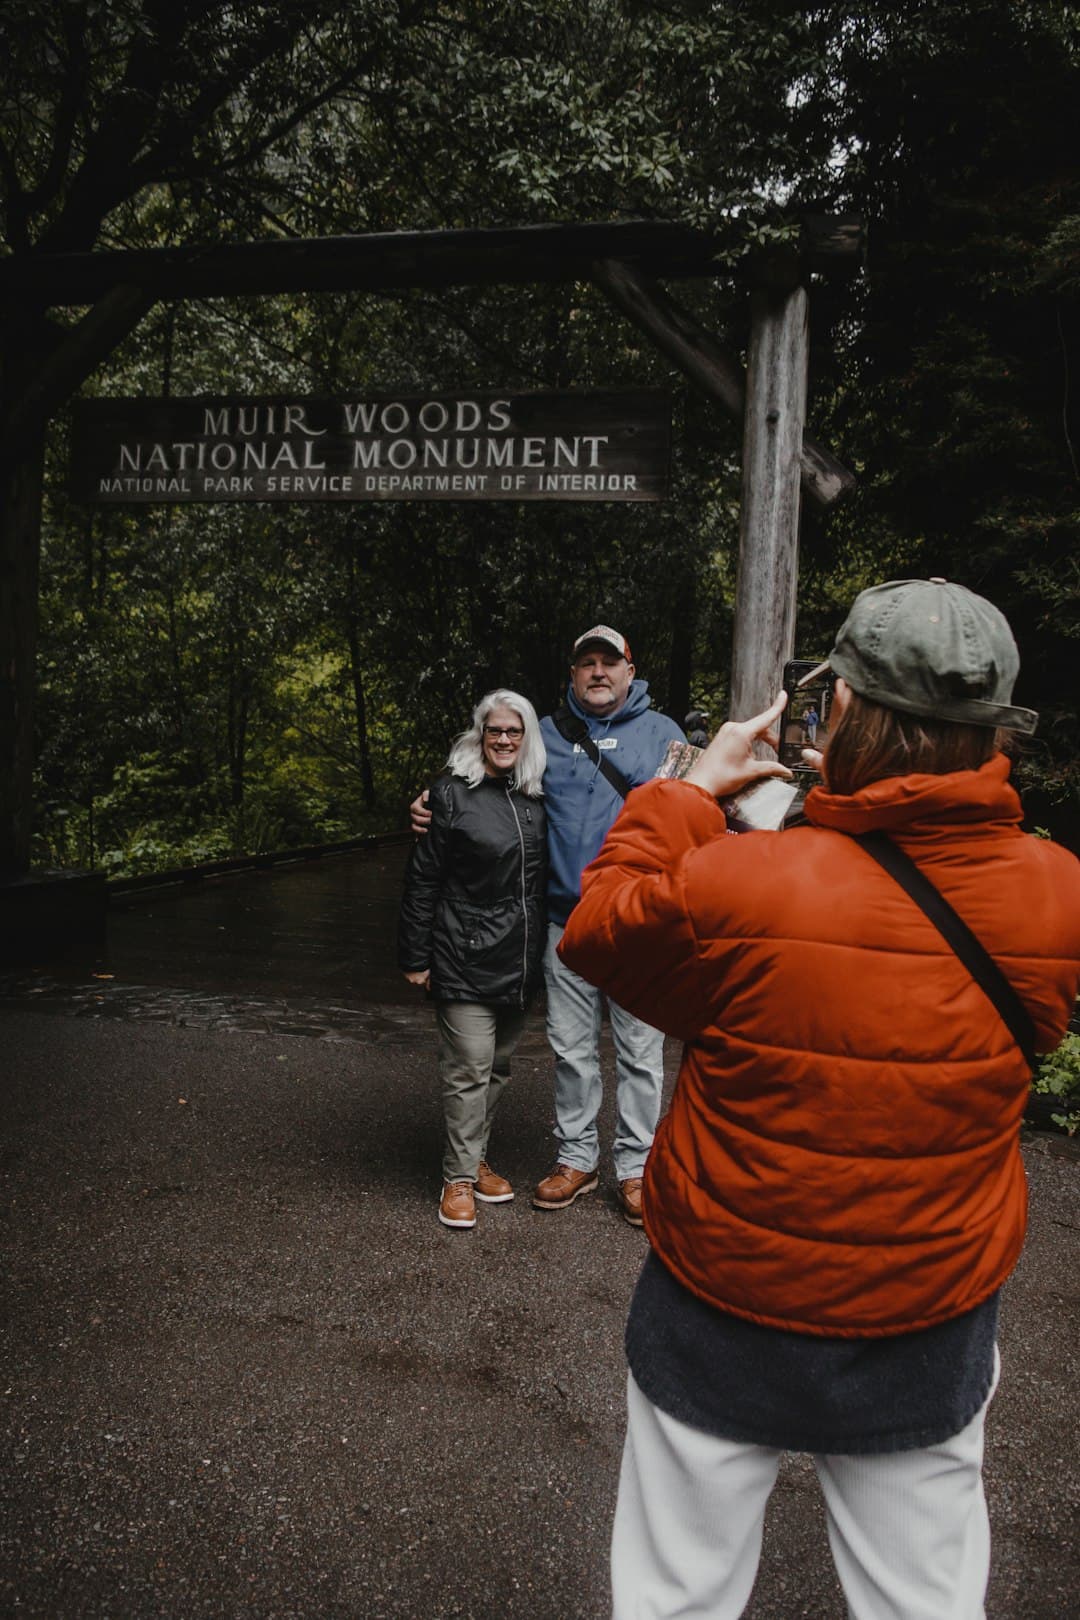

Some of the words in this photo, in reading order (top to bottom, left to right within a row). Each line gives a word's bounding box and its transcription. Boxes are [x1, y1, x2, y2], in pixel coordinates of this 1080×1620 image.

[203, 405, 328, 436] MUIR
[344, 400, 512, 434] WOODS
[119, 441, 326, 472] NATIONAL
[353, 435, 609, 470] MONUMENT
[99, 477, 191, 493] NATIONAL
[203, 475, 255, 493] PARK
[266, 475, 353, 493] SERVICE
[365, 474, 488, 492] DEPARTMENT
[500, 474, 526, 491] OF
[538, 473, 638, 491] INTERIOR
